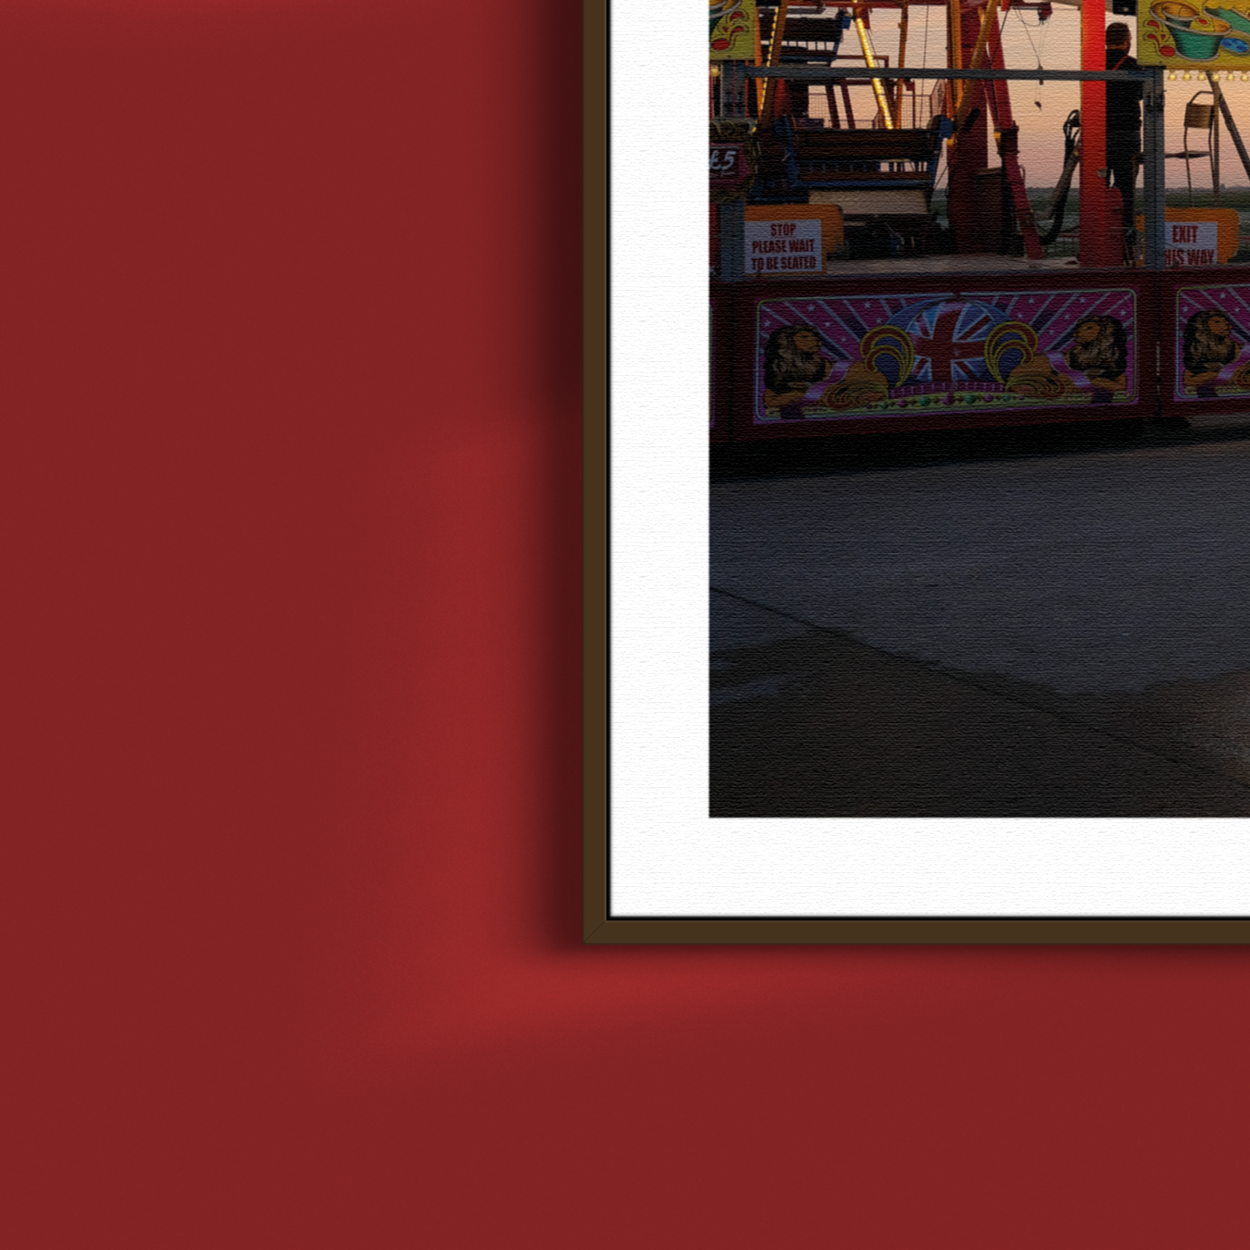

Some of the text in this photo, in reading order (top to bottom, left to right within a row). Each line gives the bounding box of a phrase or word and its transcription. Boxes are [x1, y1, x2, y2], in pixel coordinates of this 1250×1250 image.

[709, 150, 737, 170] £5
[770, 223, 796, 236] STOP
[1172, 225, 1199, 243] EXIT
[752, 239, 815, 254] PLEASE WAIT
[751, 256, 816, 270] TO BE SEATED
[1163, 249, 1215, 266] HIS WAY
